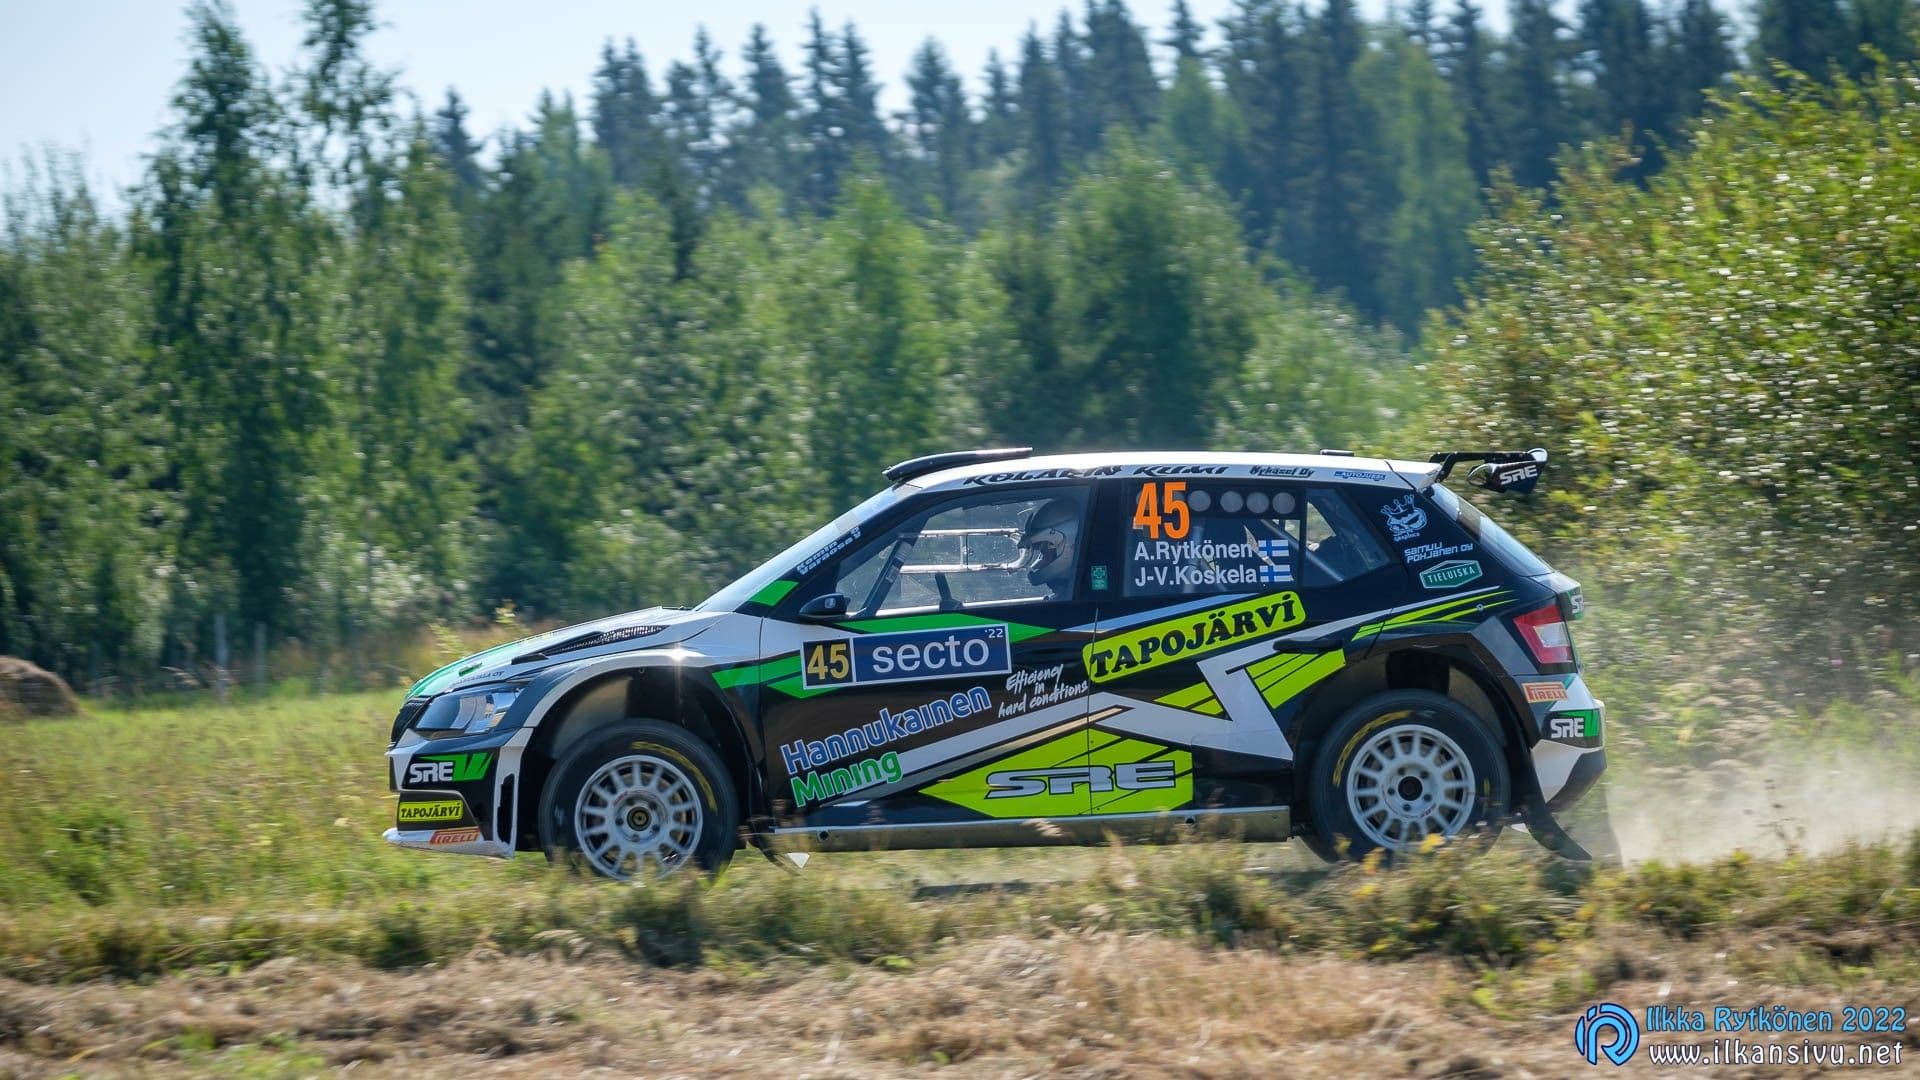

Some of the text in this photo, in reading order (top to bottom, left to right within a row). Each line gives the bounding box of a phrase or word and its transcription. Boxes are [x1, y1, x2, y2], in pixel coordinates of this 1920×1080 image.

[963, 465, 1229, 486] KOLARIN KUMI
[1500, 464, 1538, 485] SRE
[1134, 480, 1190, 540] 45
[1134, 540, 1253, 565] A.Rytkönen
[1135, 565, 1258, 587] J-V.Koskela
[1426, 565, 1476, 583] TIELUISKA
[1088, 592, 1298, 678] TAPOJÄRVI
[806, 643, 850, 681] 45
[872, 635, 990, 674] secto
[1006, 663, 1064, 695] Efficiency
[1035, 682, 1045, 695] in
[998, 680, 1089, 718] hard conditions
[1525, 683, 1568, 701] PIRELLI
[780, 686, 992, 774] Hannukainen
[1550, 717, 1585, 739] SRE
[409, 761, 454, 783] SRE
[790, 751, 903, 808] Mining
[984, 760, 1176, 799] SRE
[401, 803, 461, 818] TAPOJÄRVI
[429, 830, 479, 845] PIRELLI
